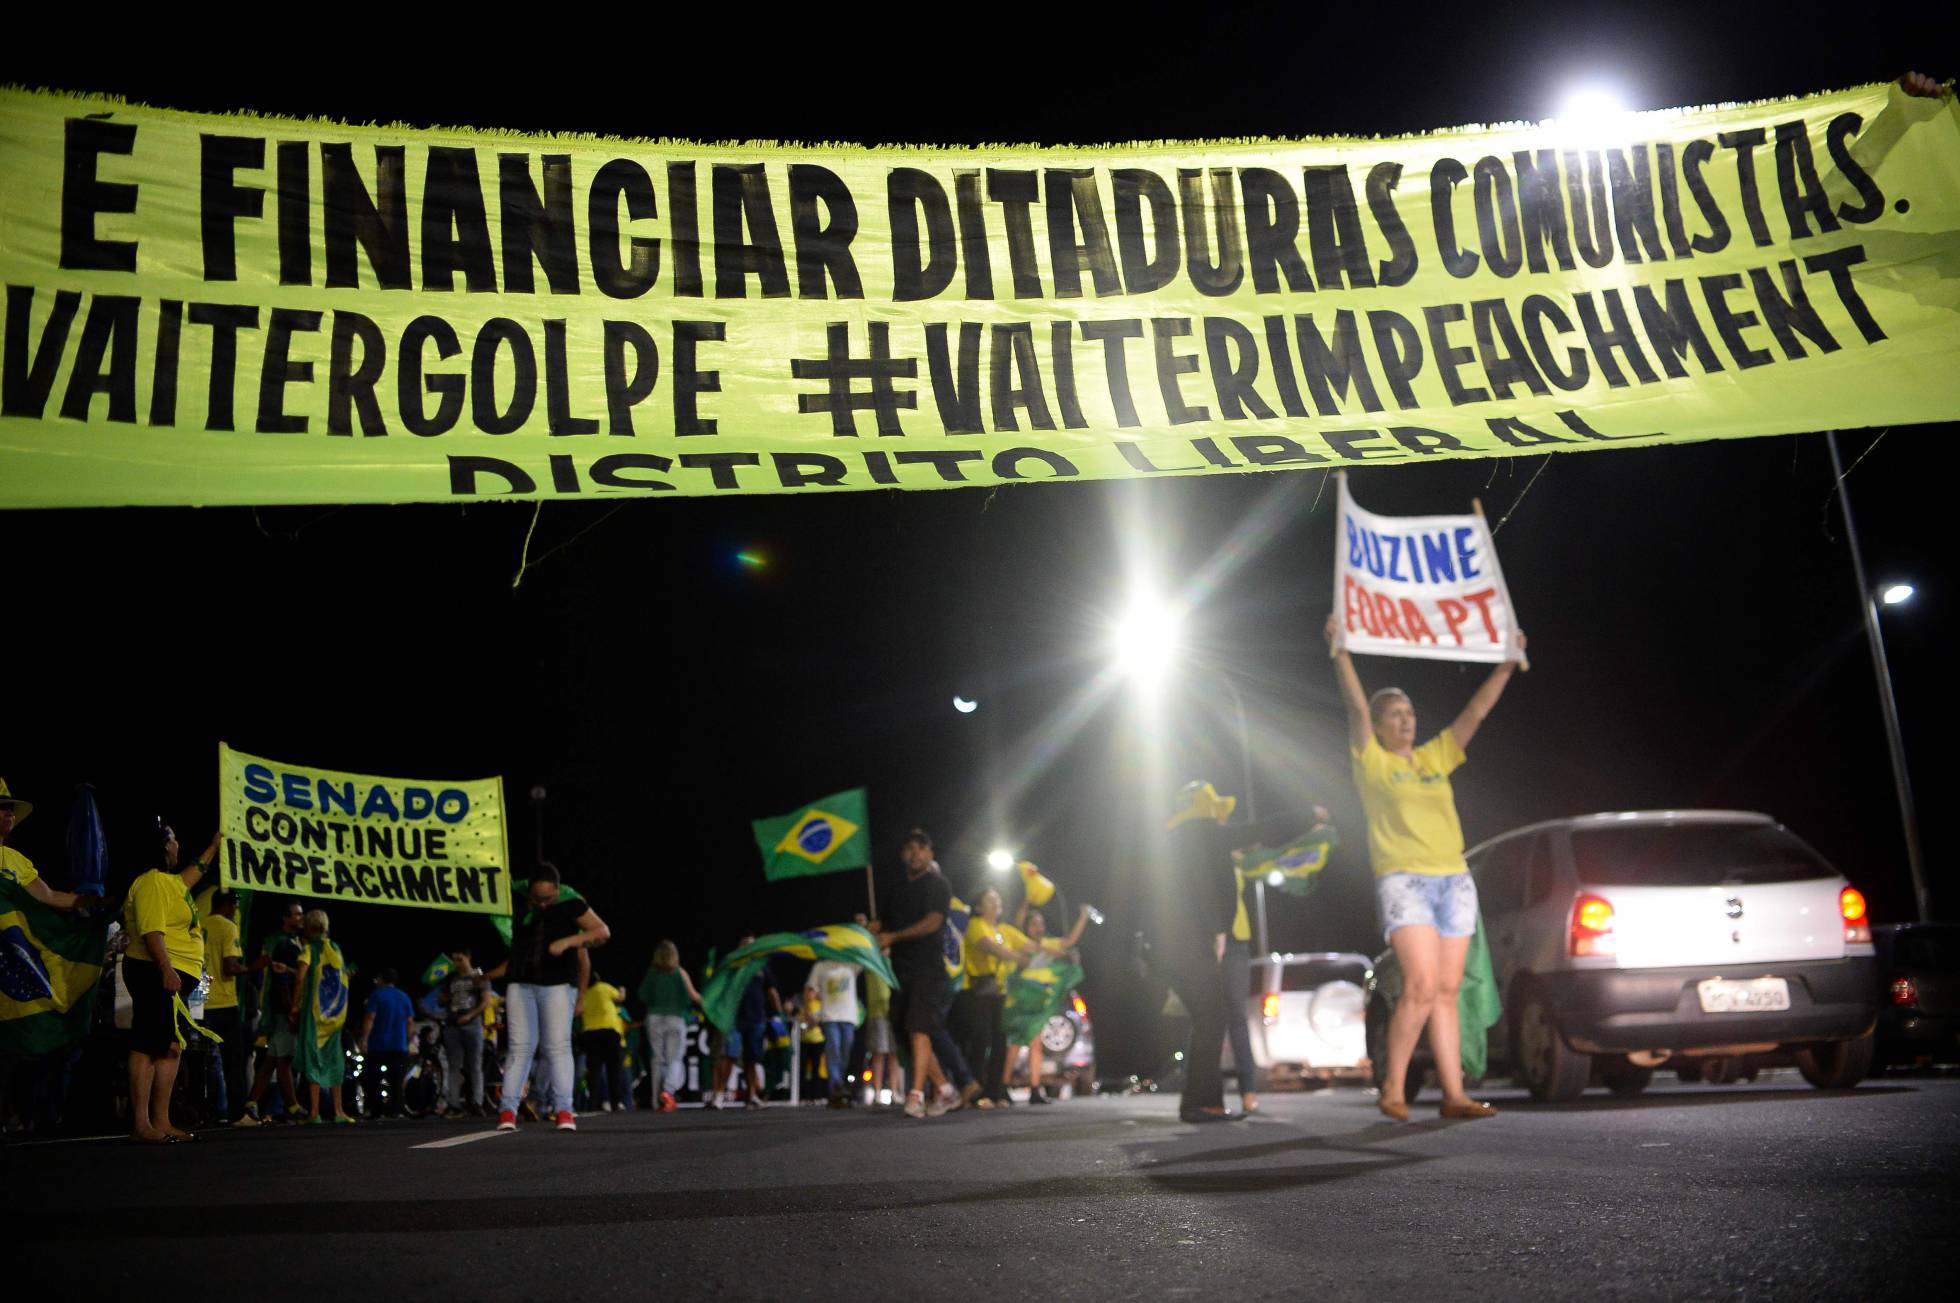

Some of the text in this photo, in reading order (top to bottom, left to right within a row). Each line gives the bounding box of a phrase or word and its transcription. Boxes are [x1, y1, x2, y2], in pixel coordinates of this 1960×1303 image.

[59, 112, 1911, 301] É FINANCIAR DITADURAS COMUNISTAS.
[791, 245, 1888, 437] #VAITERIMPEACHMENT
[447, 447, 1080, 494] DISTRITO
[1345, 513, 1480, 584] BUZINE
[1344, 574, 1499, 647] FORA PT
[244, 763, 469, 823] SENADO
[245, 806, 448, 860] CONTINUE
[226, 838, 502, 904] IMPEACHMENT
